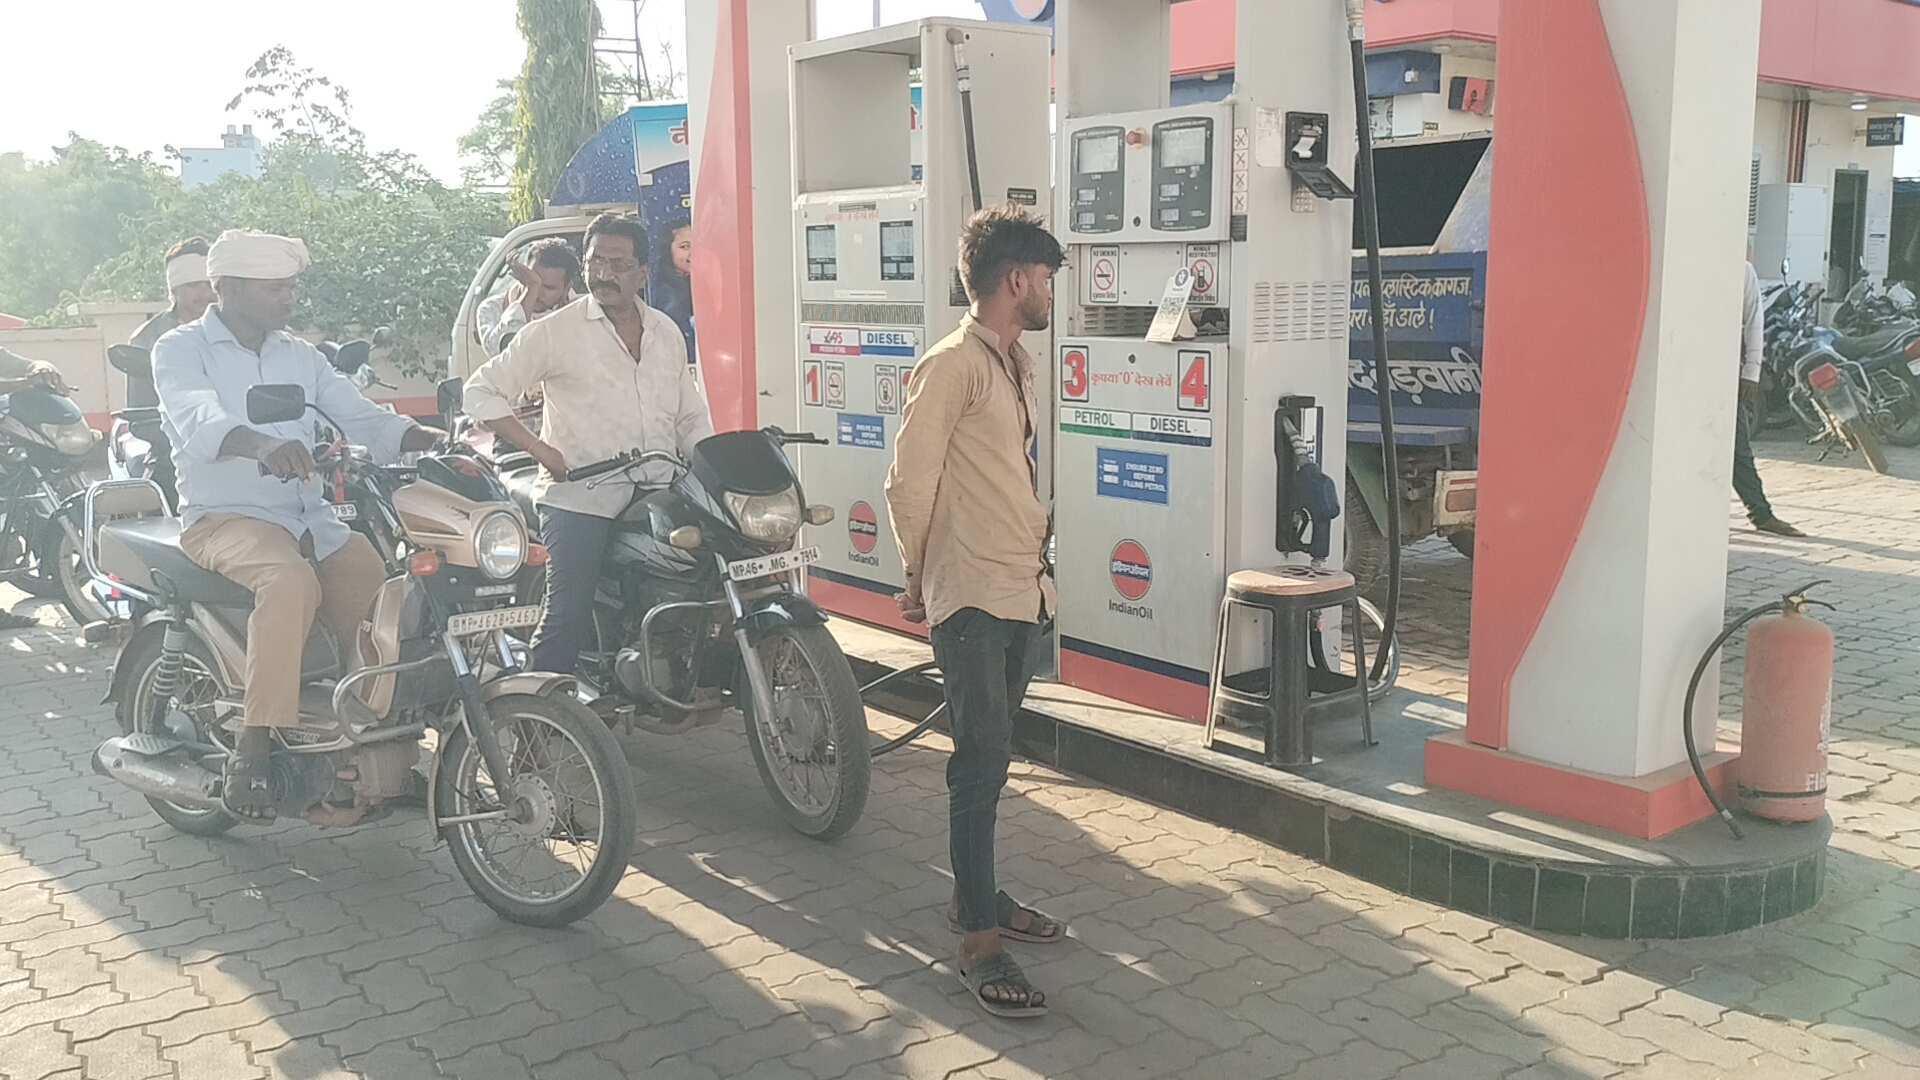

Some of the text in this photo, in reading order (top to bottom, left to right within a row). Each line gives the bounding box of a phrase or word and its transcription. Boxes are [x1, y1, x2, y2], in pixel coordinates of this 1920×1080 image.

[867, 333, 908, 345] DIESEL
[1064, 350, 1087, 397] 3
[1090, 373, 1119, 387] कृपया
[1135, 372, 1153, 386] देख
[1181, 356, 1208, 407] 4
[806, 365, 819, 402] 1
[1075, 410, 1115, 426] PETROL
[1150, 417, 1191, 433] DIESEL
[1125, 462, 1164, 474] ENSURE ZERO
[1133, 472, 1156, 482] BEFORE
[1123, 480, 1166, 492] FILLING PETROL
[800, 547, 818, 563] 7914
[848, 551, 880, 567] IndianOil
[1108, 599, 1153, 619] IndianOil
